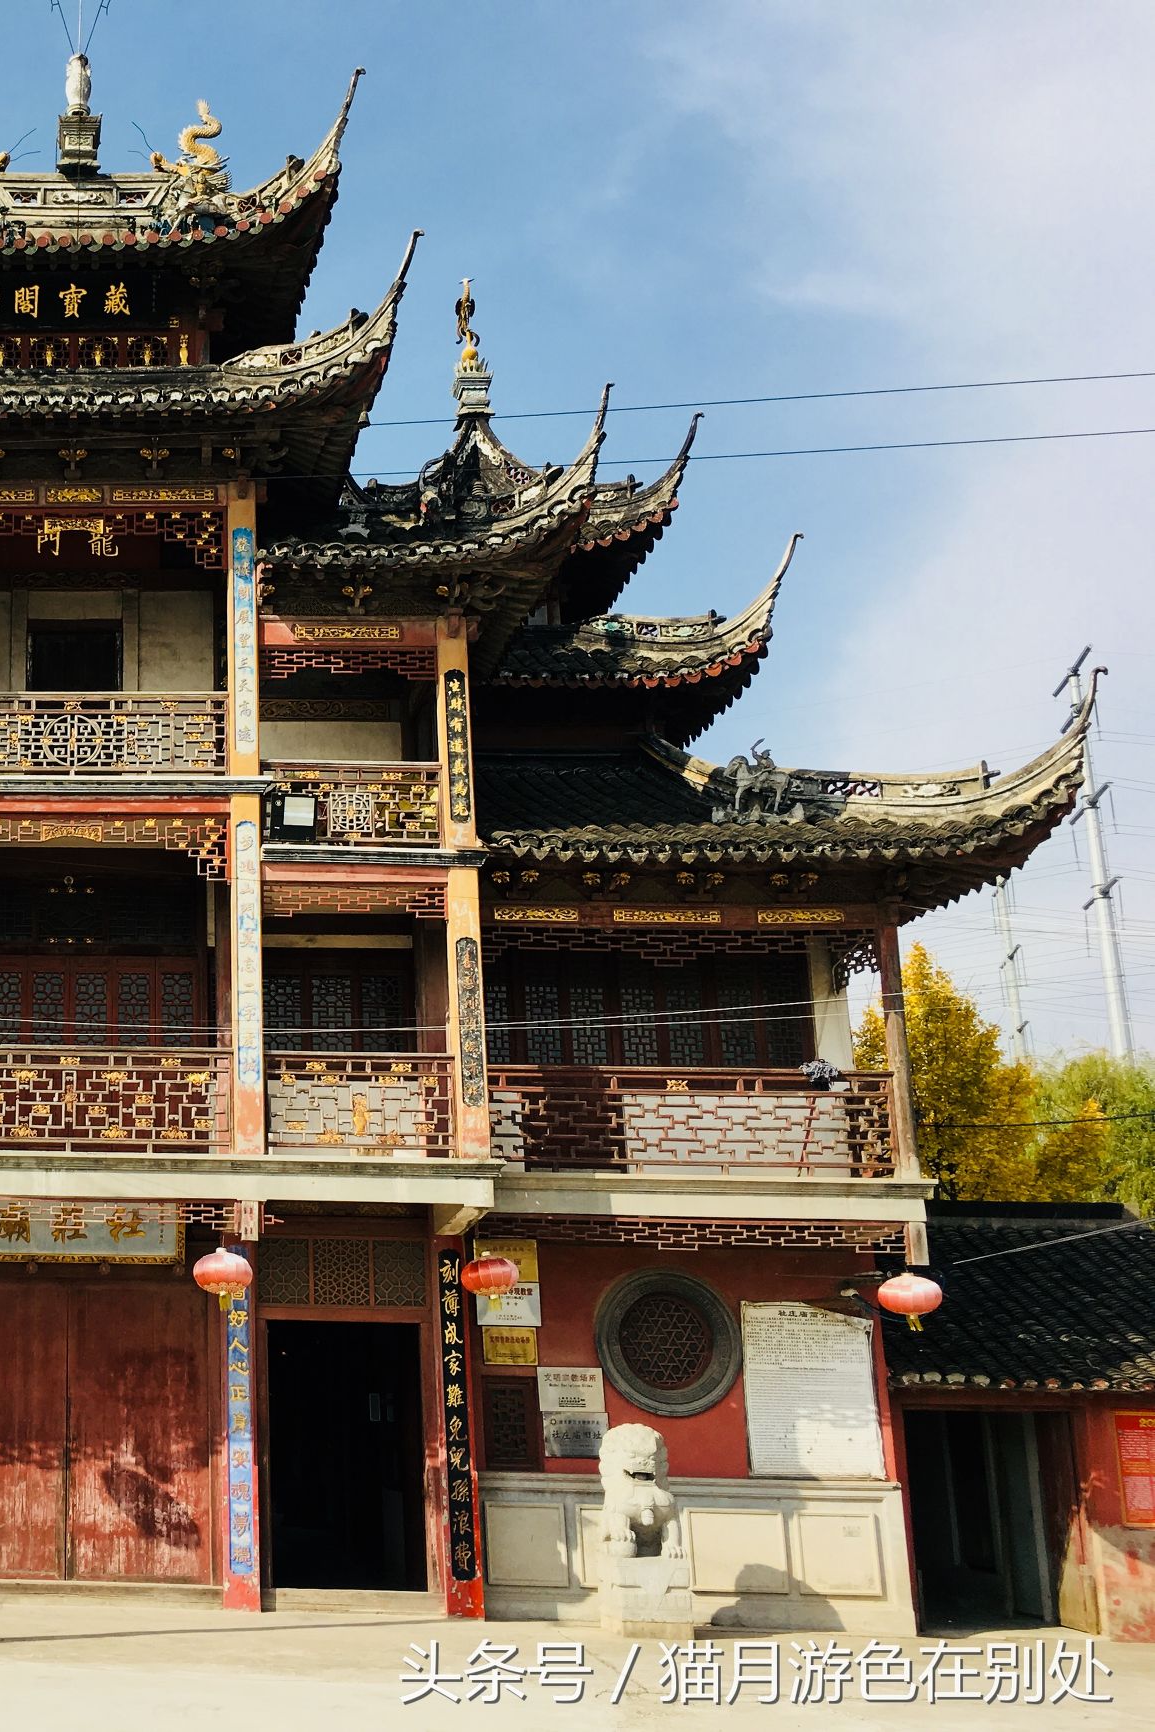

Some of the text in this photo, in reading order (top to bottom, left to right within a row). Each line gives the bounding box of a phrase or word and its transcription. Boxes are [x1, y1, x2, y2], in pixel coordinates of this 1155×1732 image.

[14, 282, 131, 318] 藏寶閣
[37, 527, 119, 557] 龍門
